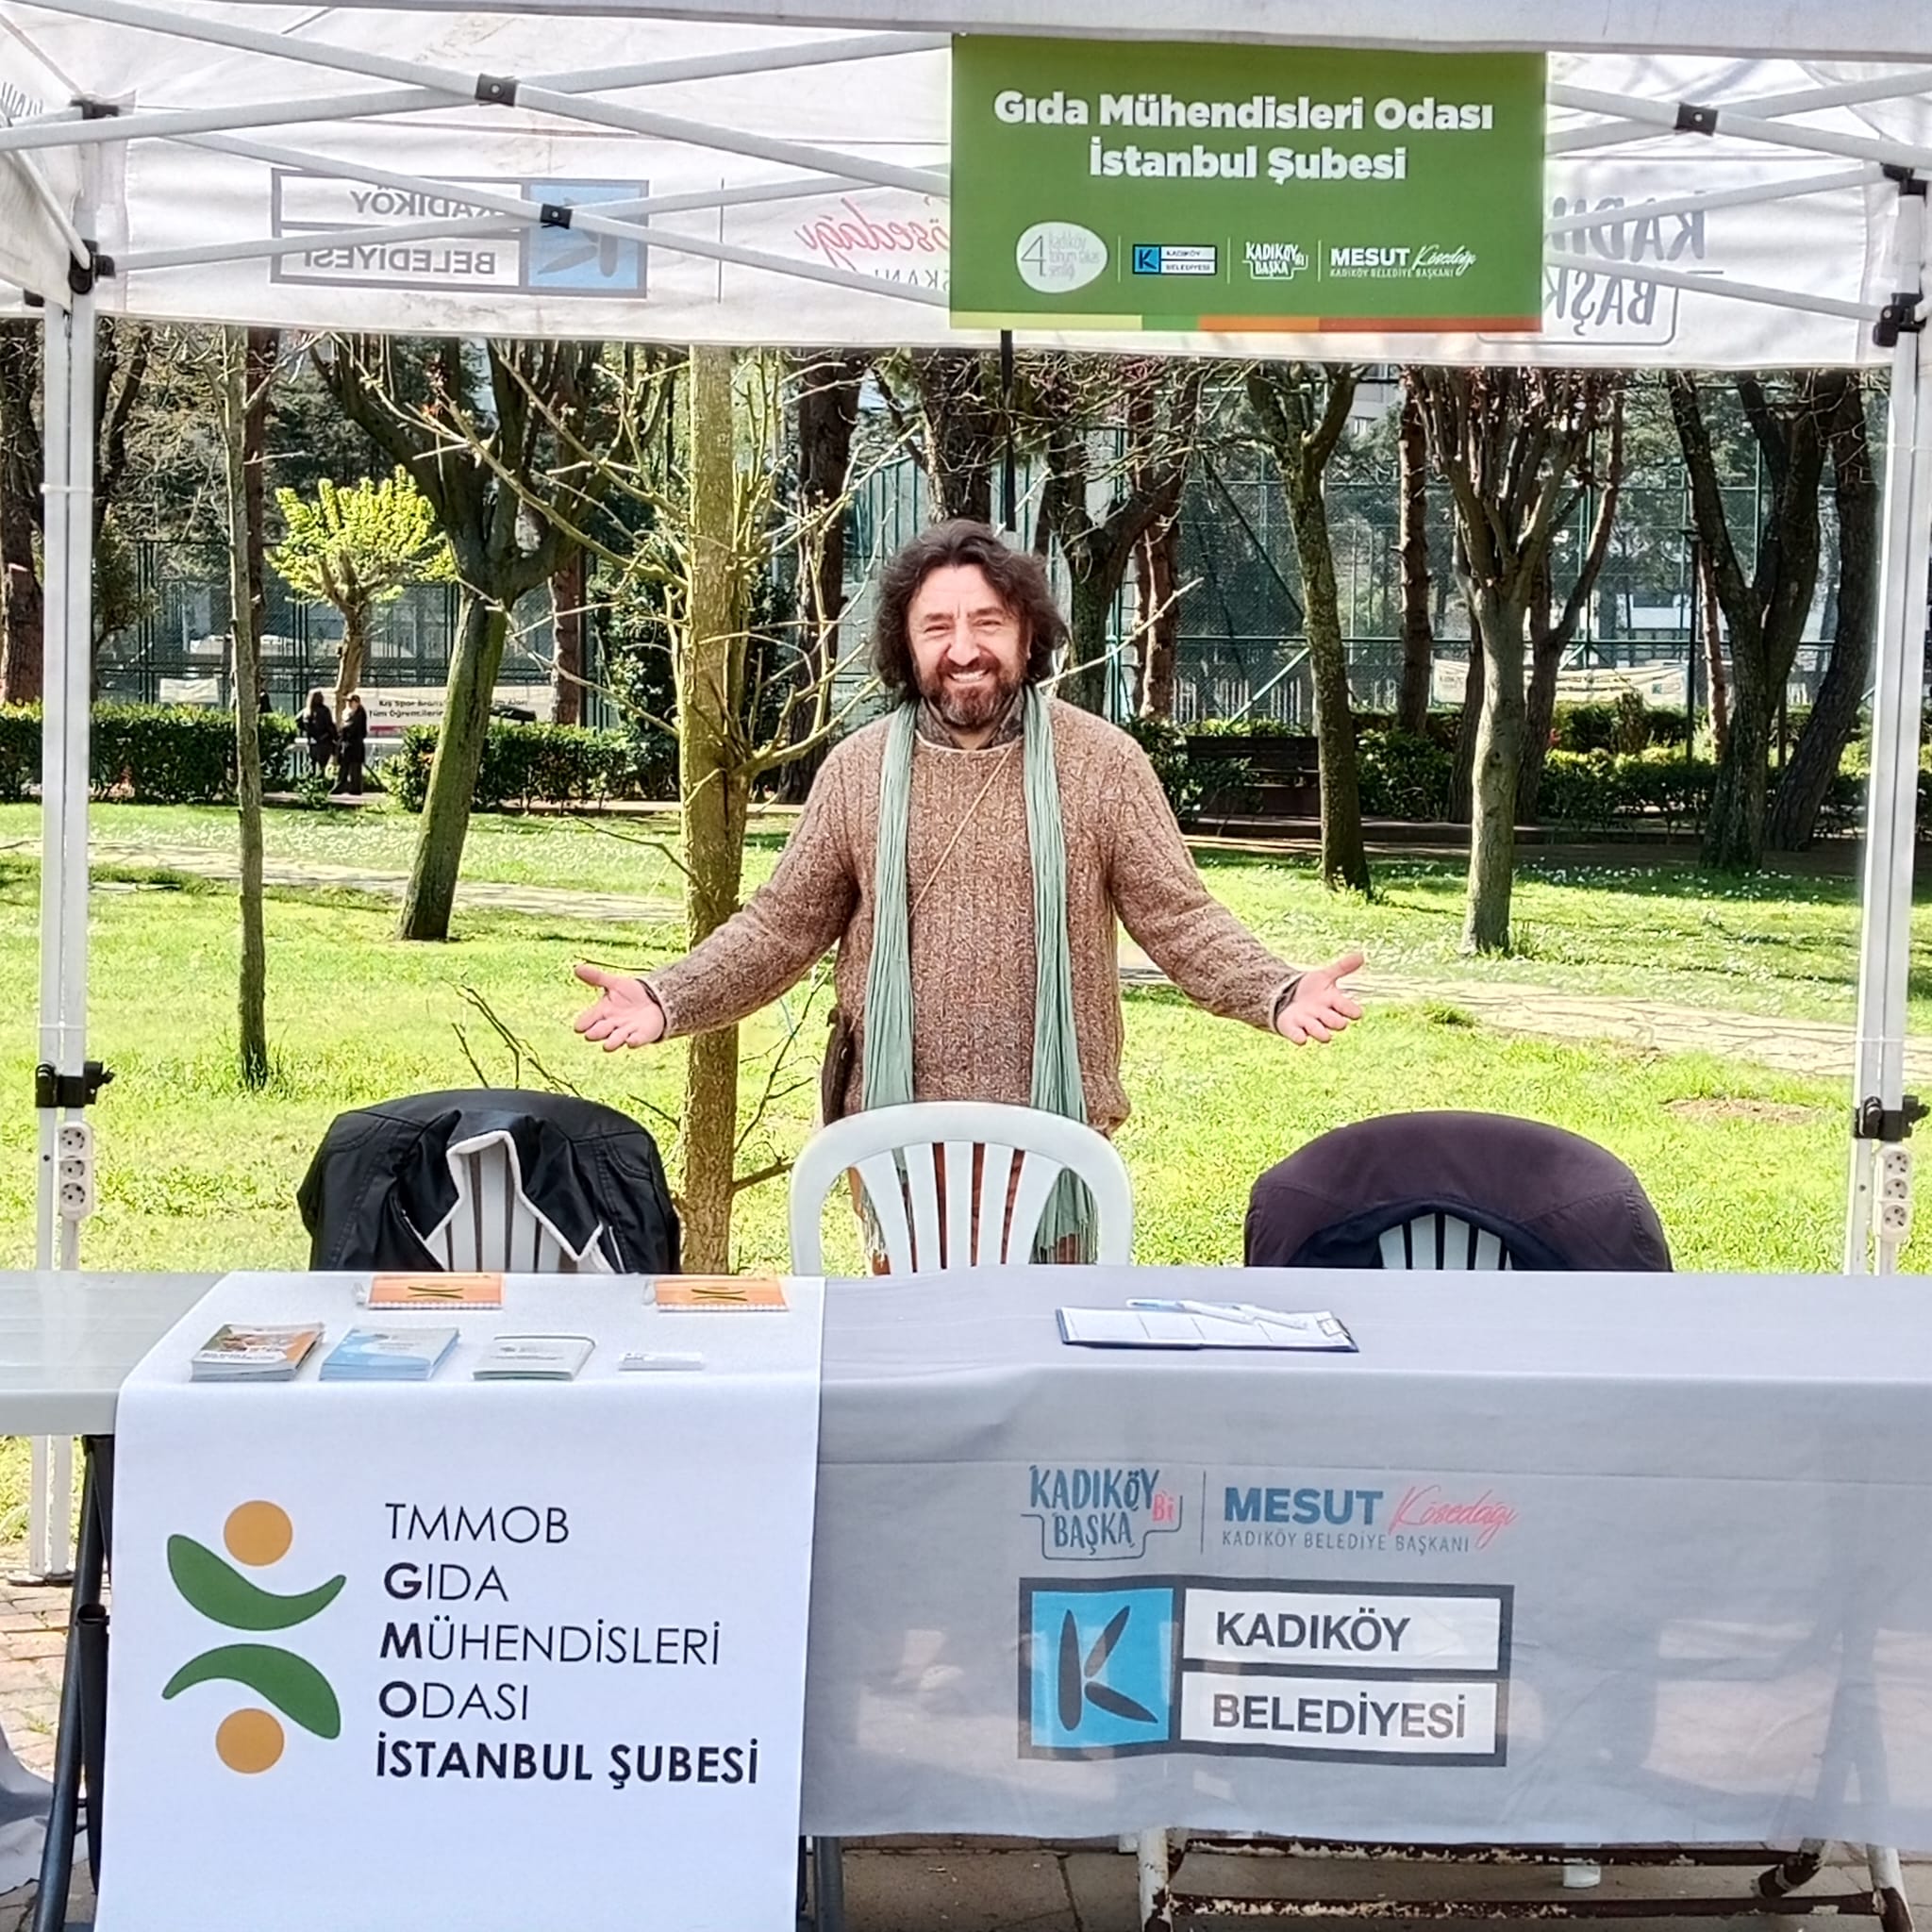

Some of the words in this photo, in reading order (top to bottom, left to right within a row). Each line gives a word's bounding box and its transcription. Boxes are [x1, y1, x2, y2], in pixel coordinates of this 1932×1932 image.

[994, 91, 1089, 125] Gıda
[1100, 93, 1363, 129] Mühendisleri
[1374, 97, 1493, 130] Odası
[1090, 136, 1257, 178] İstanbul
[1268, 146, 1407, 186] Şubesi
[1330, 247, 1410, 266] MESUT
[1029, 1465, 1159, 1511] KADIKÖY
[1224, 1487, 1384, 1526] MESUT
[385, 1503, 570, 1543] TMMOB
[1052, 1511, 1135, 1555] BAŞKA
[1222, 1530, 1297, 1548] KADIKÖY
[1304, 1531, 1387, 1551] BELEDİYE
[1394, 1535, 1470, 1556] BAŞKANI
[384, 1561, 509, 1602] GIDA
[379, 1614, 720, 1665] MÜHENDİSLERİ
[1216, 1607, 1411, 1652] KADIKÖY
[378, 1681, 528, 1720] ODASI
[1212, 1691, 1466, 1740] BELEDİYESİ
[377, 1731, 593, 1781] İSTANBUL
[608, 1738, 758, 1789] ŞUBESİ
